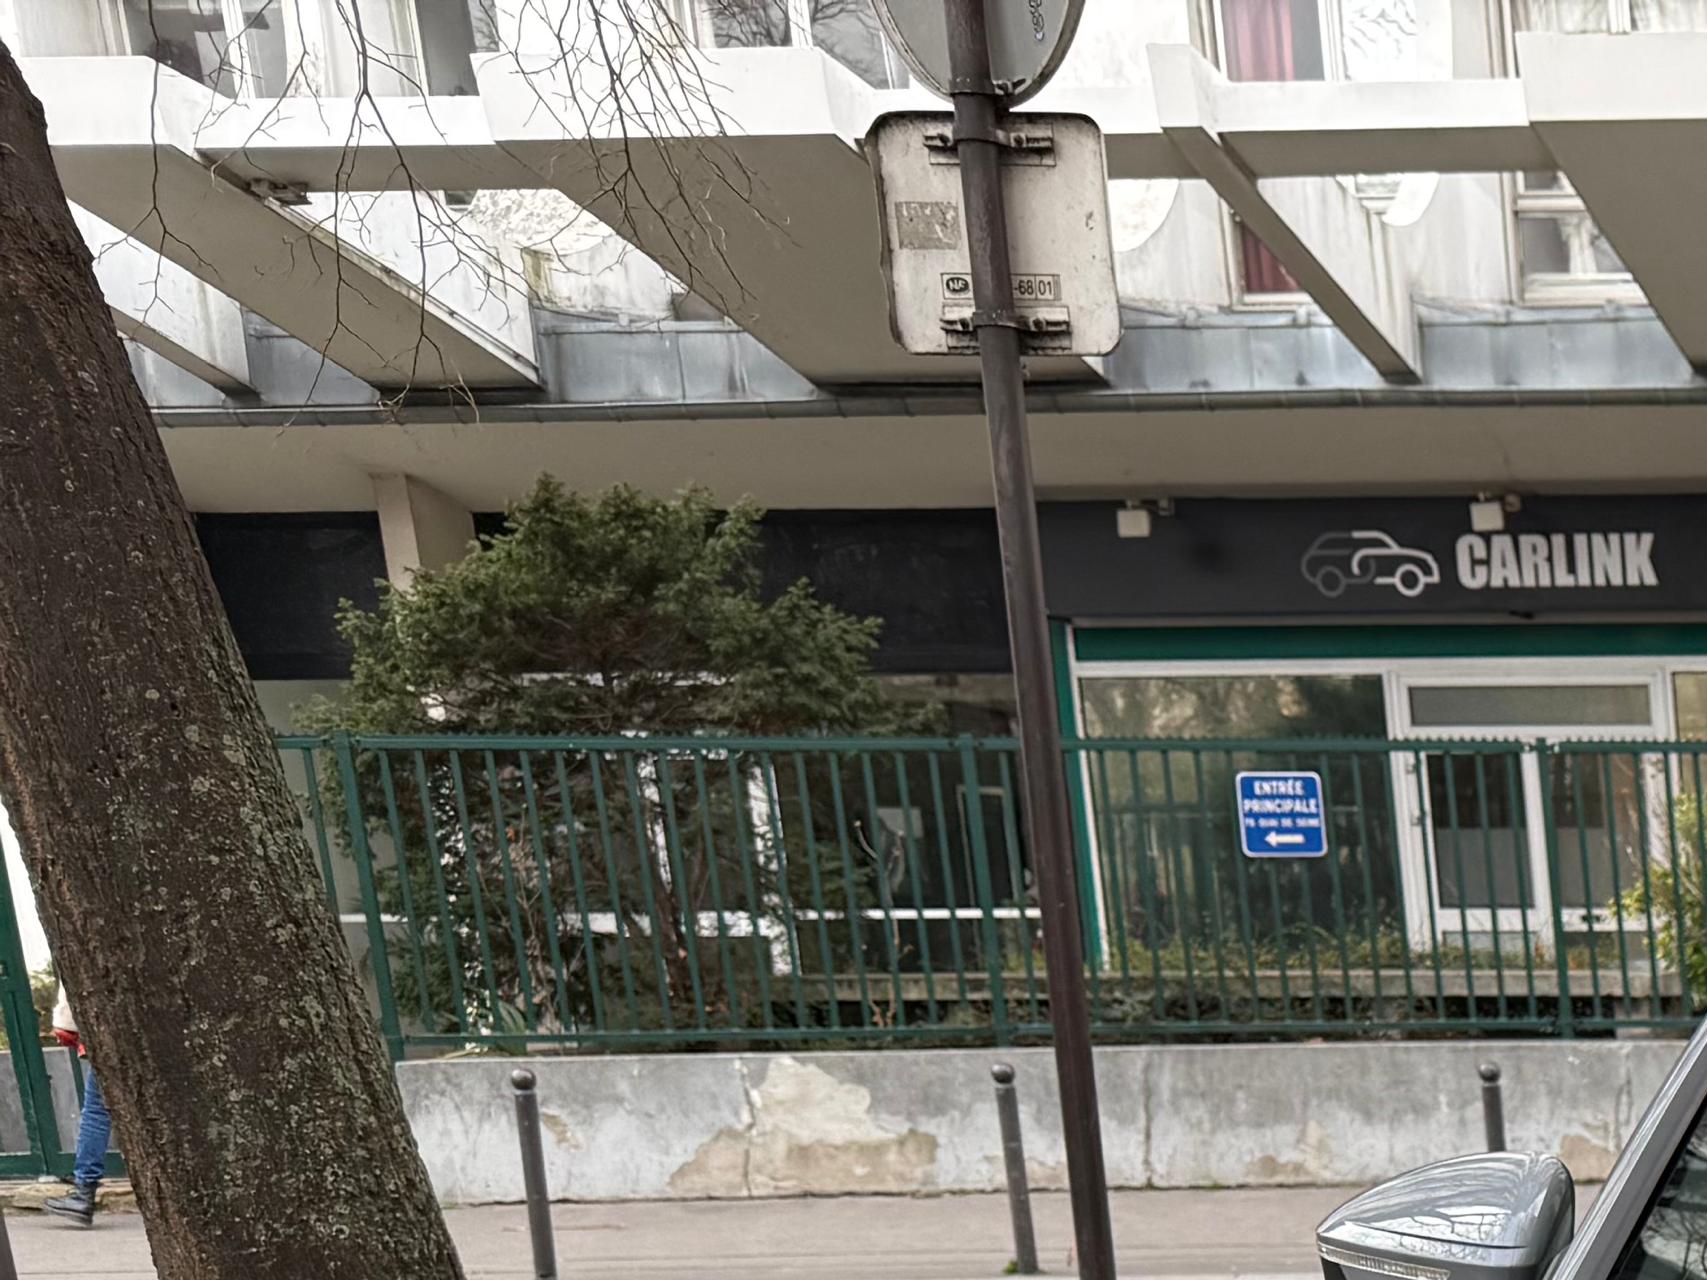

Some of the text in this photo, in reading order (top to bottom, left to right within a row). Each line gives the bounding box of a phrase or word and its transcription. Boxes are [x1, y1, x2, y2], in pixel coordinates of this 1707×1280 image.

[1455, 532, 1659, 590] CARLINK
[1254, 778, 1305, 796] ENTRÉE
[1243, 798, 1317, 814] PRINCIPALE
